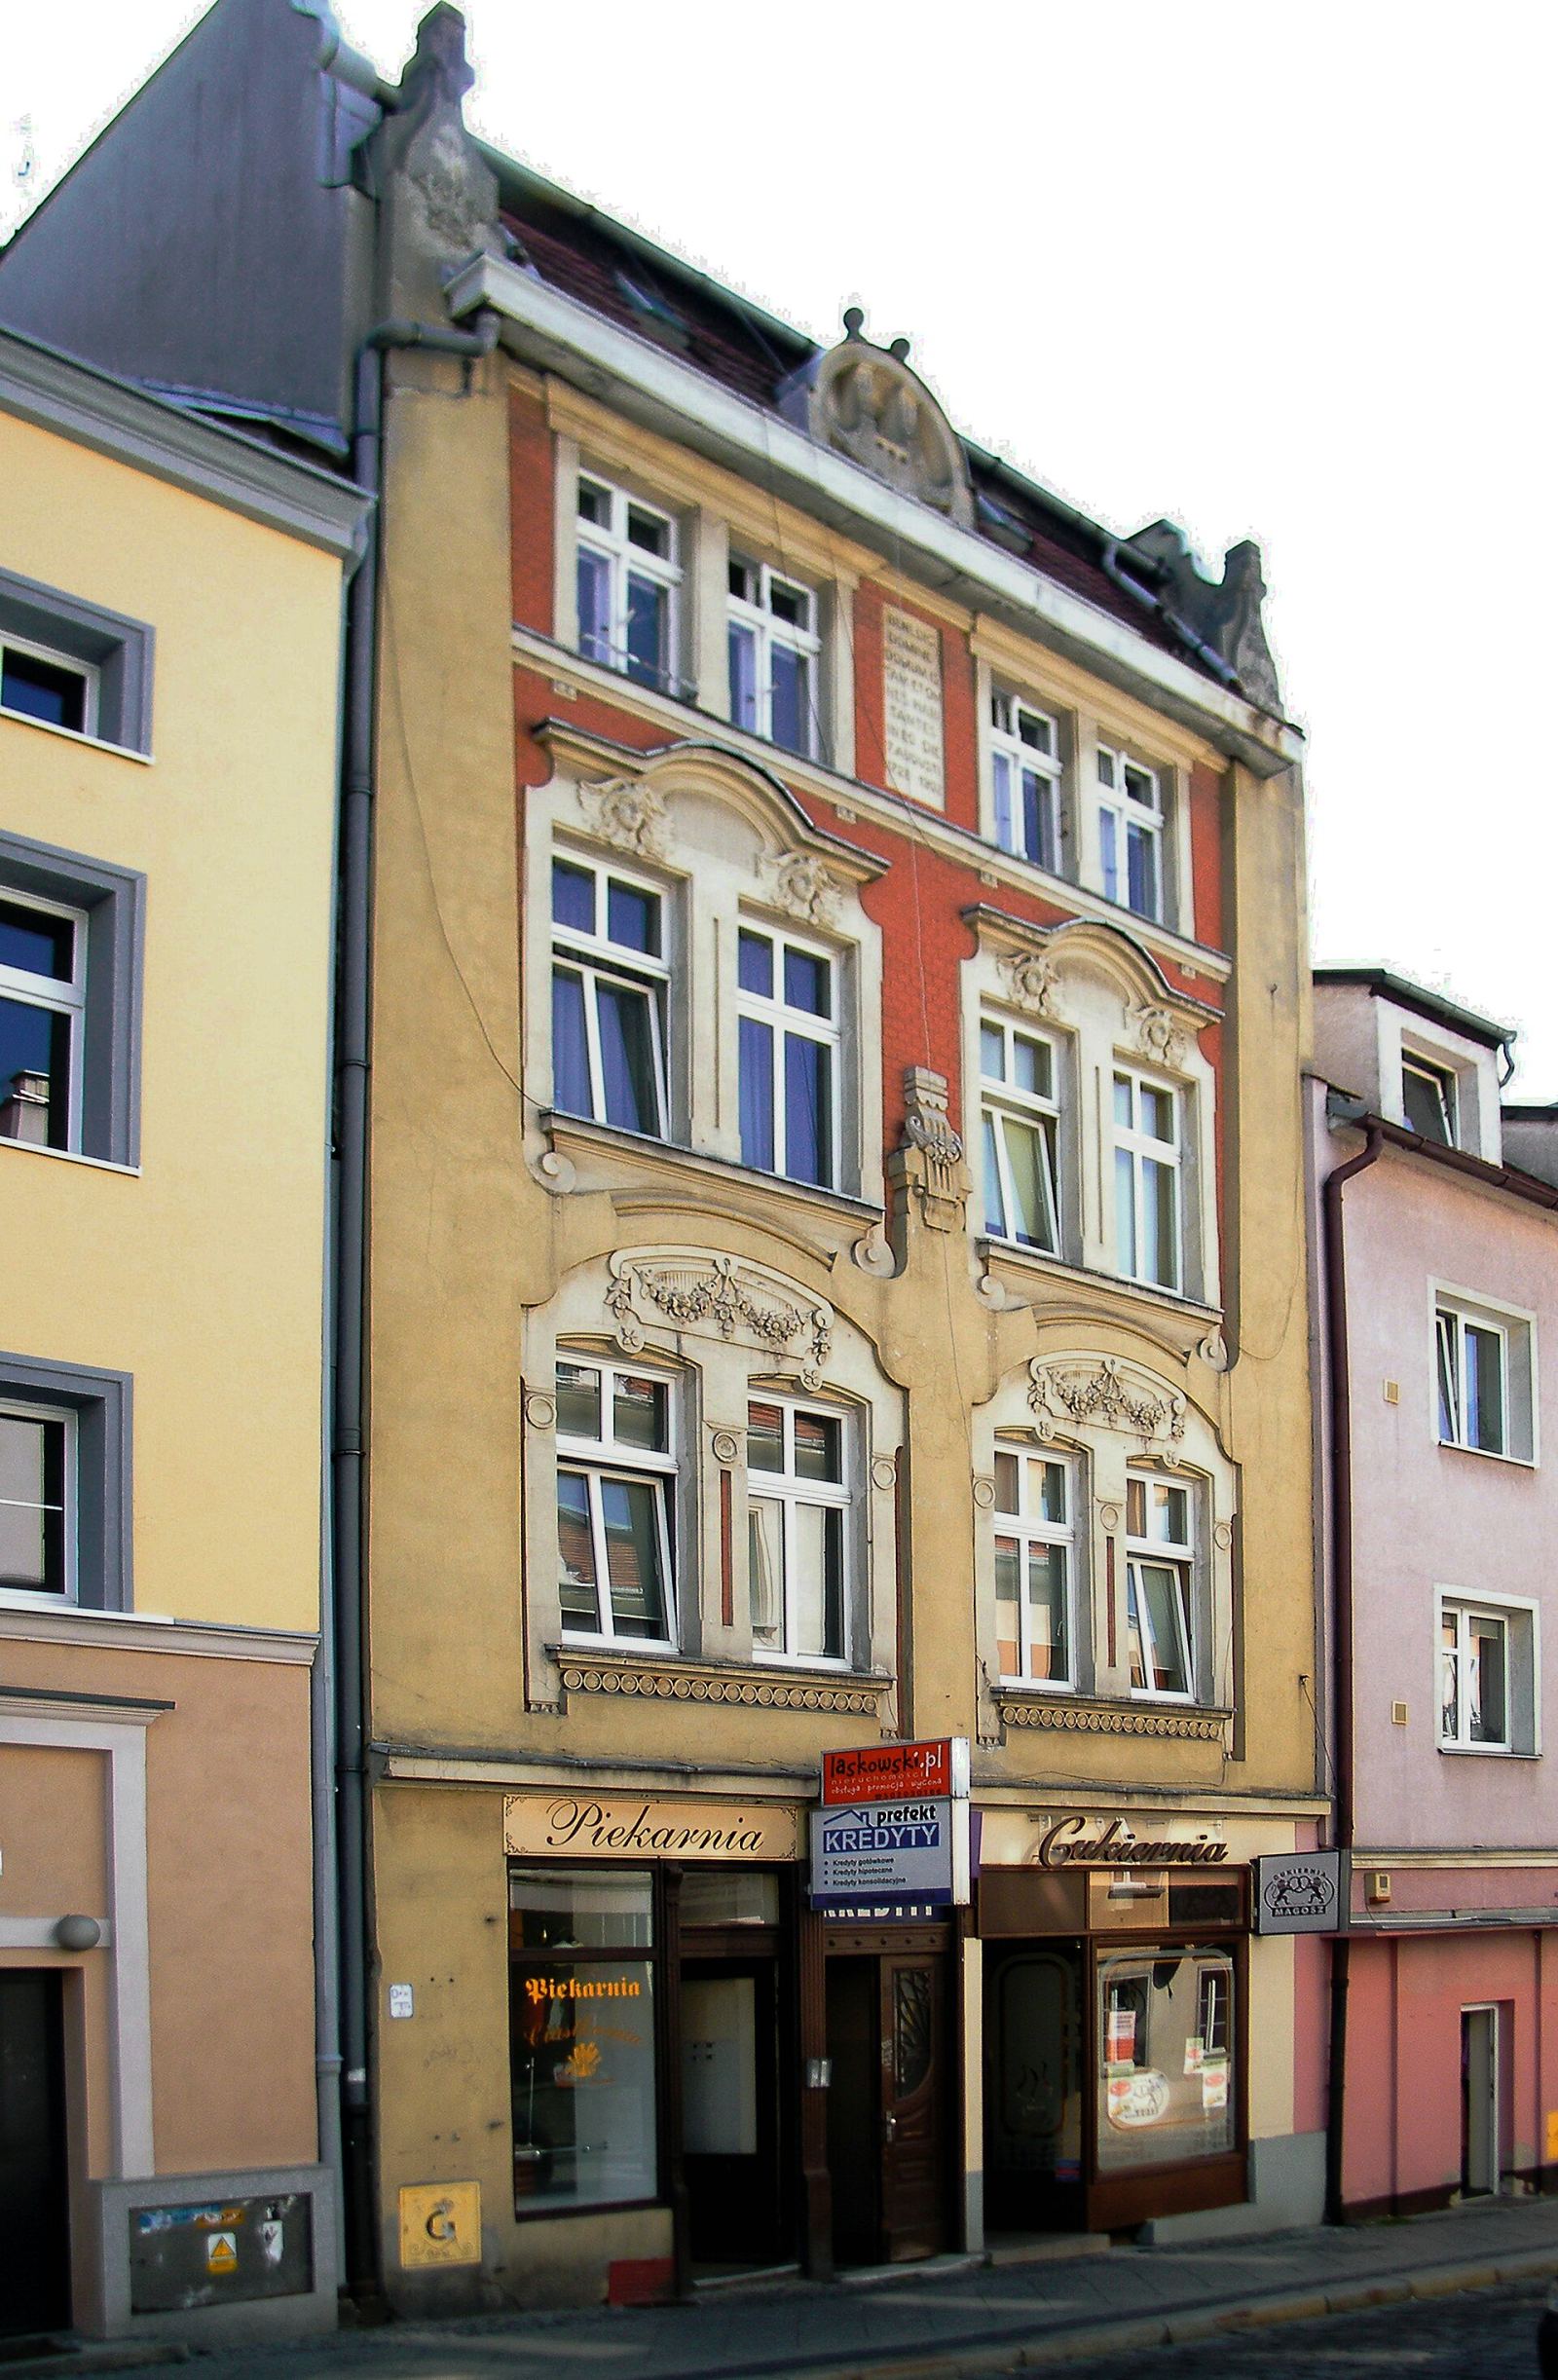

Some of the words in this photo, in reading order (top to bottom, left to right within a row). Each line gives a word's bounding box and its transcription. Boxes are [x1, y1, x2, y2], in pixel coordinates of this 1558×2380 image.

[831, 1744, 942, 1777] laskowski.pl
[546, 1798, 764, 1851] Piekarnia
[877, 1804, 937, 1826] prefekt
[826, 1824, 938, 1851] KREDYTY
[1038, 1815, 1229, 1869] Cukiernia
[1273, 1868, 1326, 1881] CUKIERNIA
[1274, 1906, 1325, 1915] MAGOSZ
[525, 1977, 641, 2004] Piekarnia
